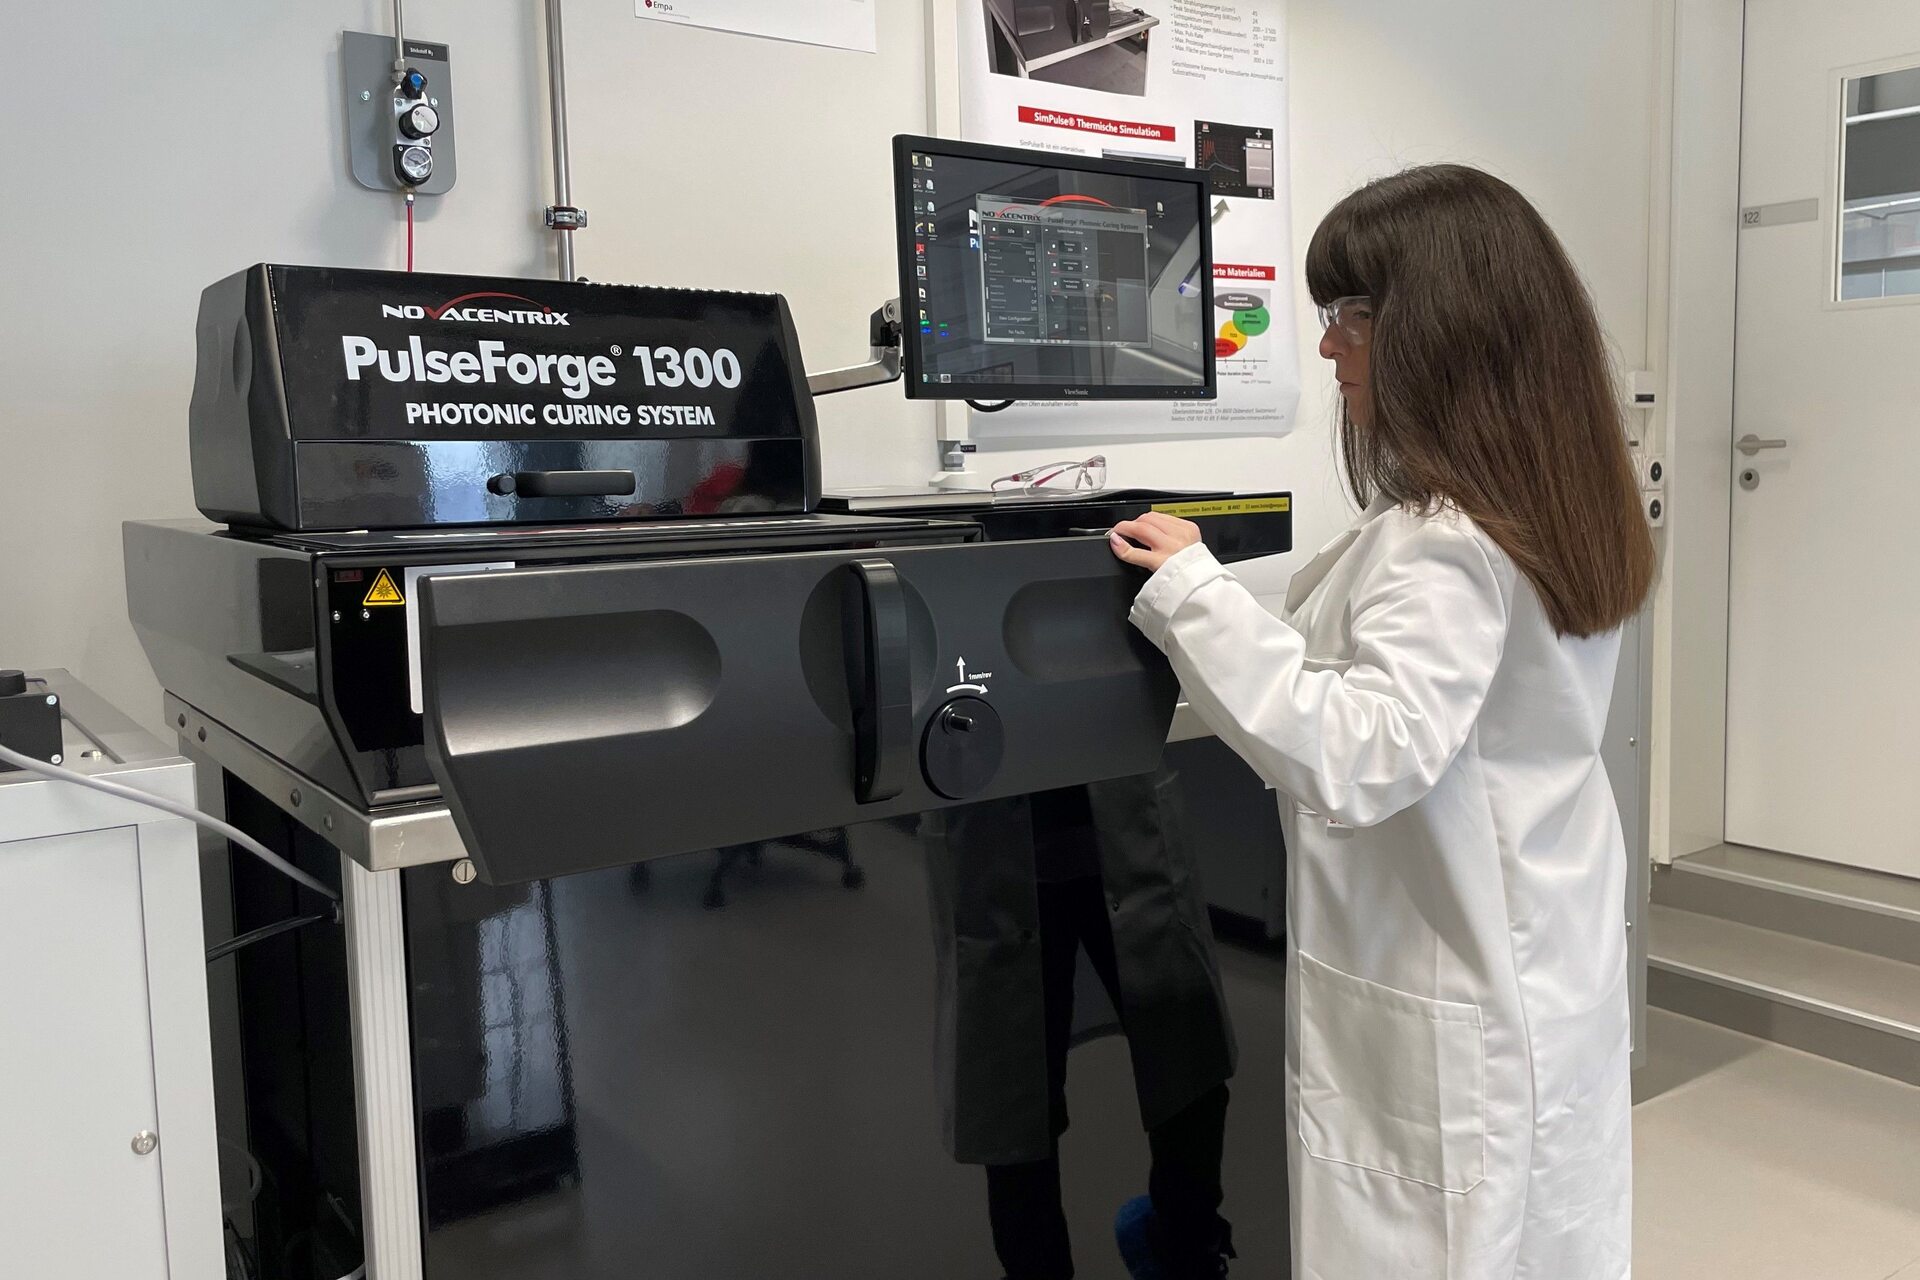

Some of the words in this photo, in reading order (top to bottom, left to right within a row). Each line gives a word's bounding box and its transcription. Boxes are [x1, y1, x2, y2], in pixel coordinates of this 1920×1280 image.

[653, 1, 673, 11] Empa
[1076, 118, 1118, 133] Thermische
[1119, 124, 1161, 138] Simulation
[982, 210, 1042, 222] NOVACENTRIX
[1744, 211, 1760, 224] 122
[1212, 267, 1226, 276] erte
[1227, 267, 1266, 278] Materialien
[382, 304, 570, 326] NOVACENTRIX
[632, 346, 741, 389] 1300
[405, 402, 536, 425] PHOTONIC
[542, 403, 630, 427] CURING
[636, 405, 715, 426] SYSTEM
